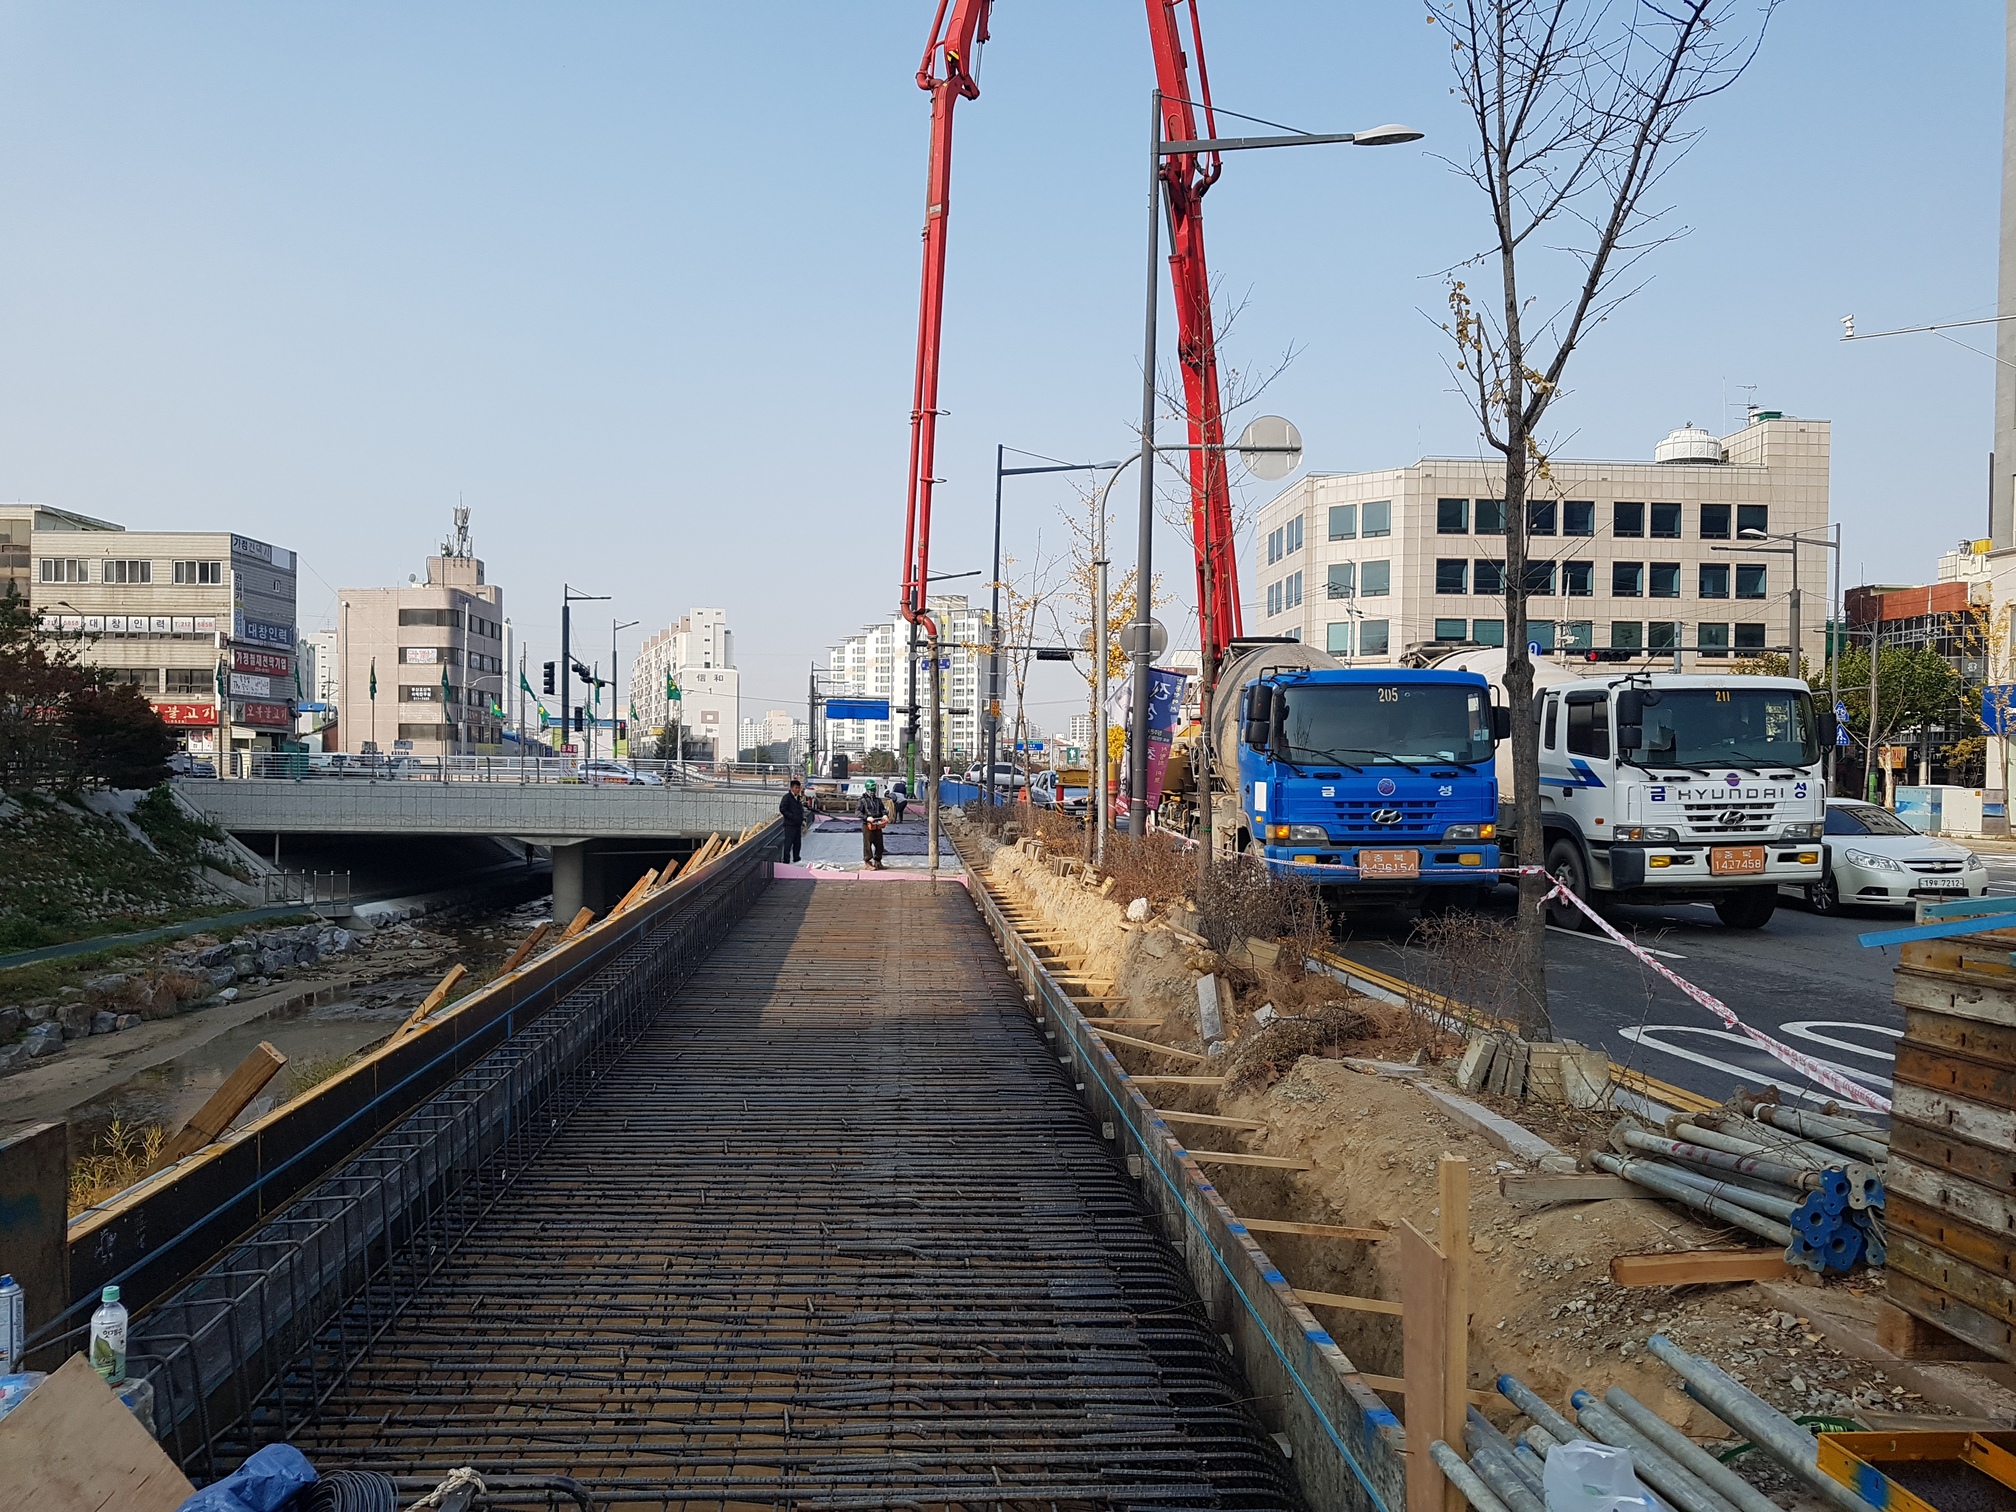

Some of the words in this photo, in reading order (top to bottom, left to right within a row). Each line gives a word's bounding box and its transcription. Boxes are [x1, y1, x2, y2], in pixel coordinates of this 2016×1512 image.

[89, 618, 165, 630] 대창인력
[248, 623, 287, 643] 대창인력
[1377, 687, 1399, 703] 205
[1715, 691, 1731, 702] 211
[1438, 785, 1453, 797] 성
[1650, 786, 1666, 802] 금
[1794, 782, 1807, 799] 성
[1677, 788, 1784, 800] HYUNDAI
[1941, 879, 1960, 887] 7212
